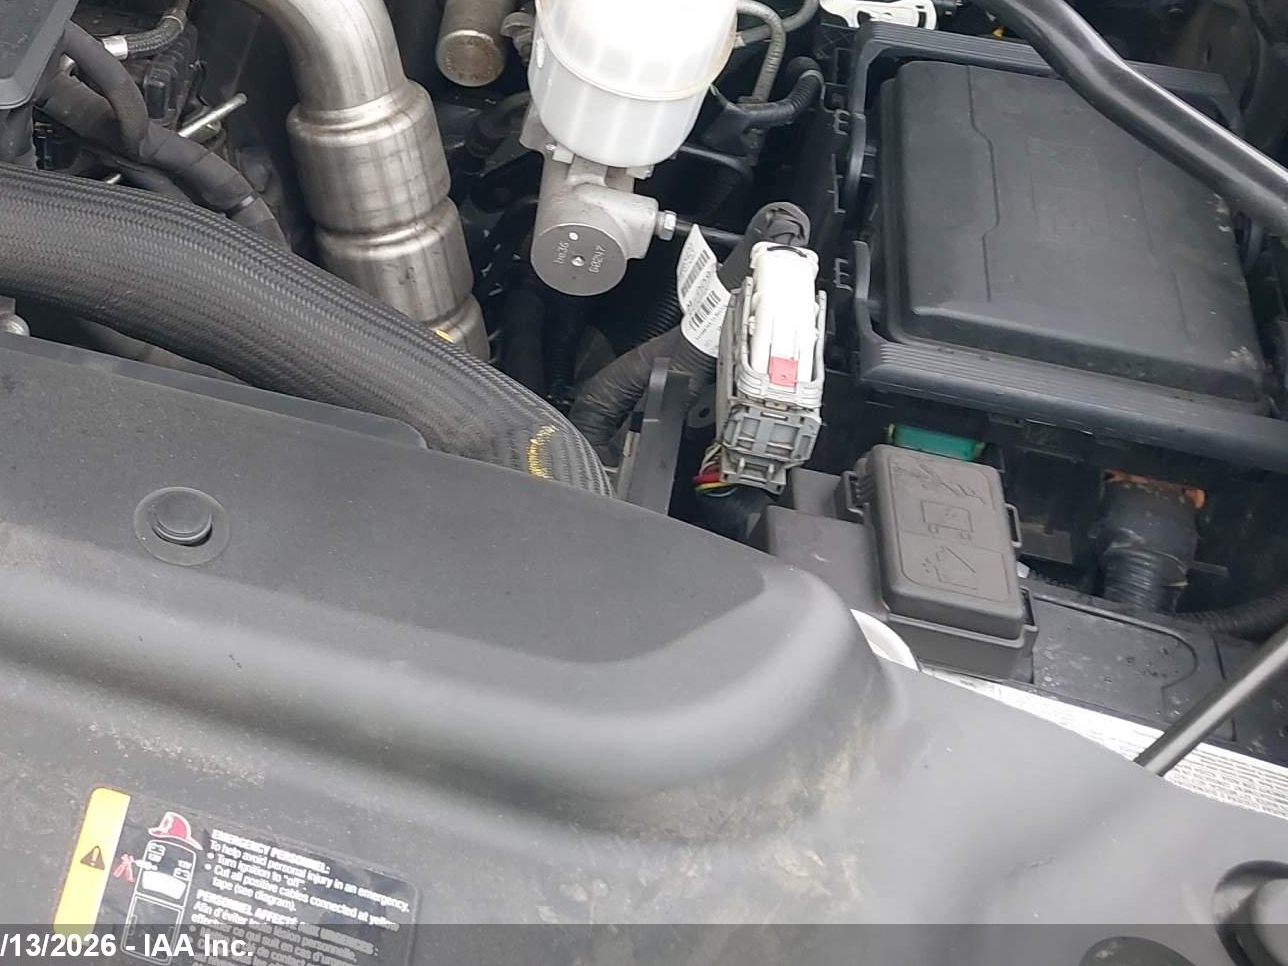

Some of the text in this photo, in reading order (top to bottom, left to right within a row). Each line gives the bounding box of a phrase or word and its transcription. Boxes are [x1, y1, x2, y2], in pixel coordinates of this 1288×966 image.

[208, 839, 411, 913] To help avoid personal injury in an emergency,
[215, 854, 237, 868] Turn
[236, 860, 271, 879] ignition
[271, 871, 282, 882] to
[193, 900, 213, 914] Afin
[211, 876, 298, 912] tape (see diagram).
[213, 864, 231, 878] Cut
[230, 869, 243, 881] all
[242, 874, 278, 893] positive
[278, 885, 309, 902] cables
[309, 894, 357, 918] connected
[357, 909, 369, 922] at
